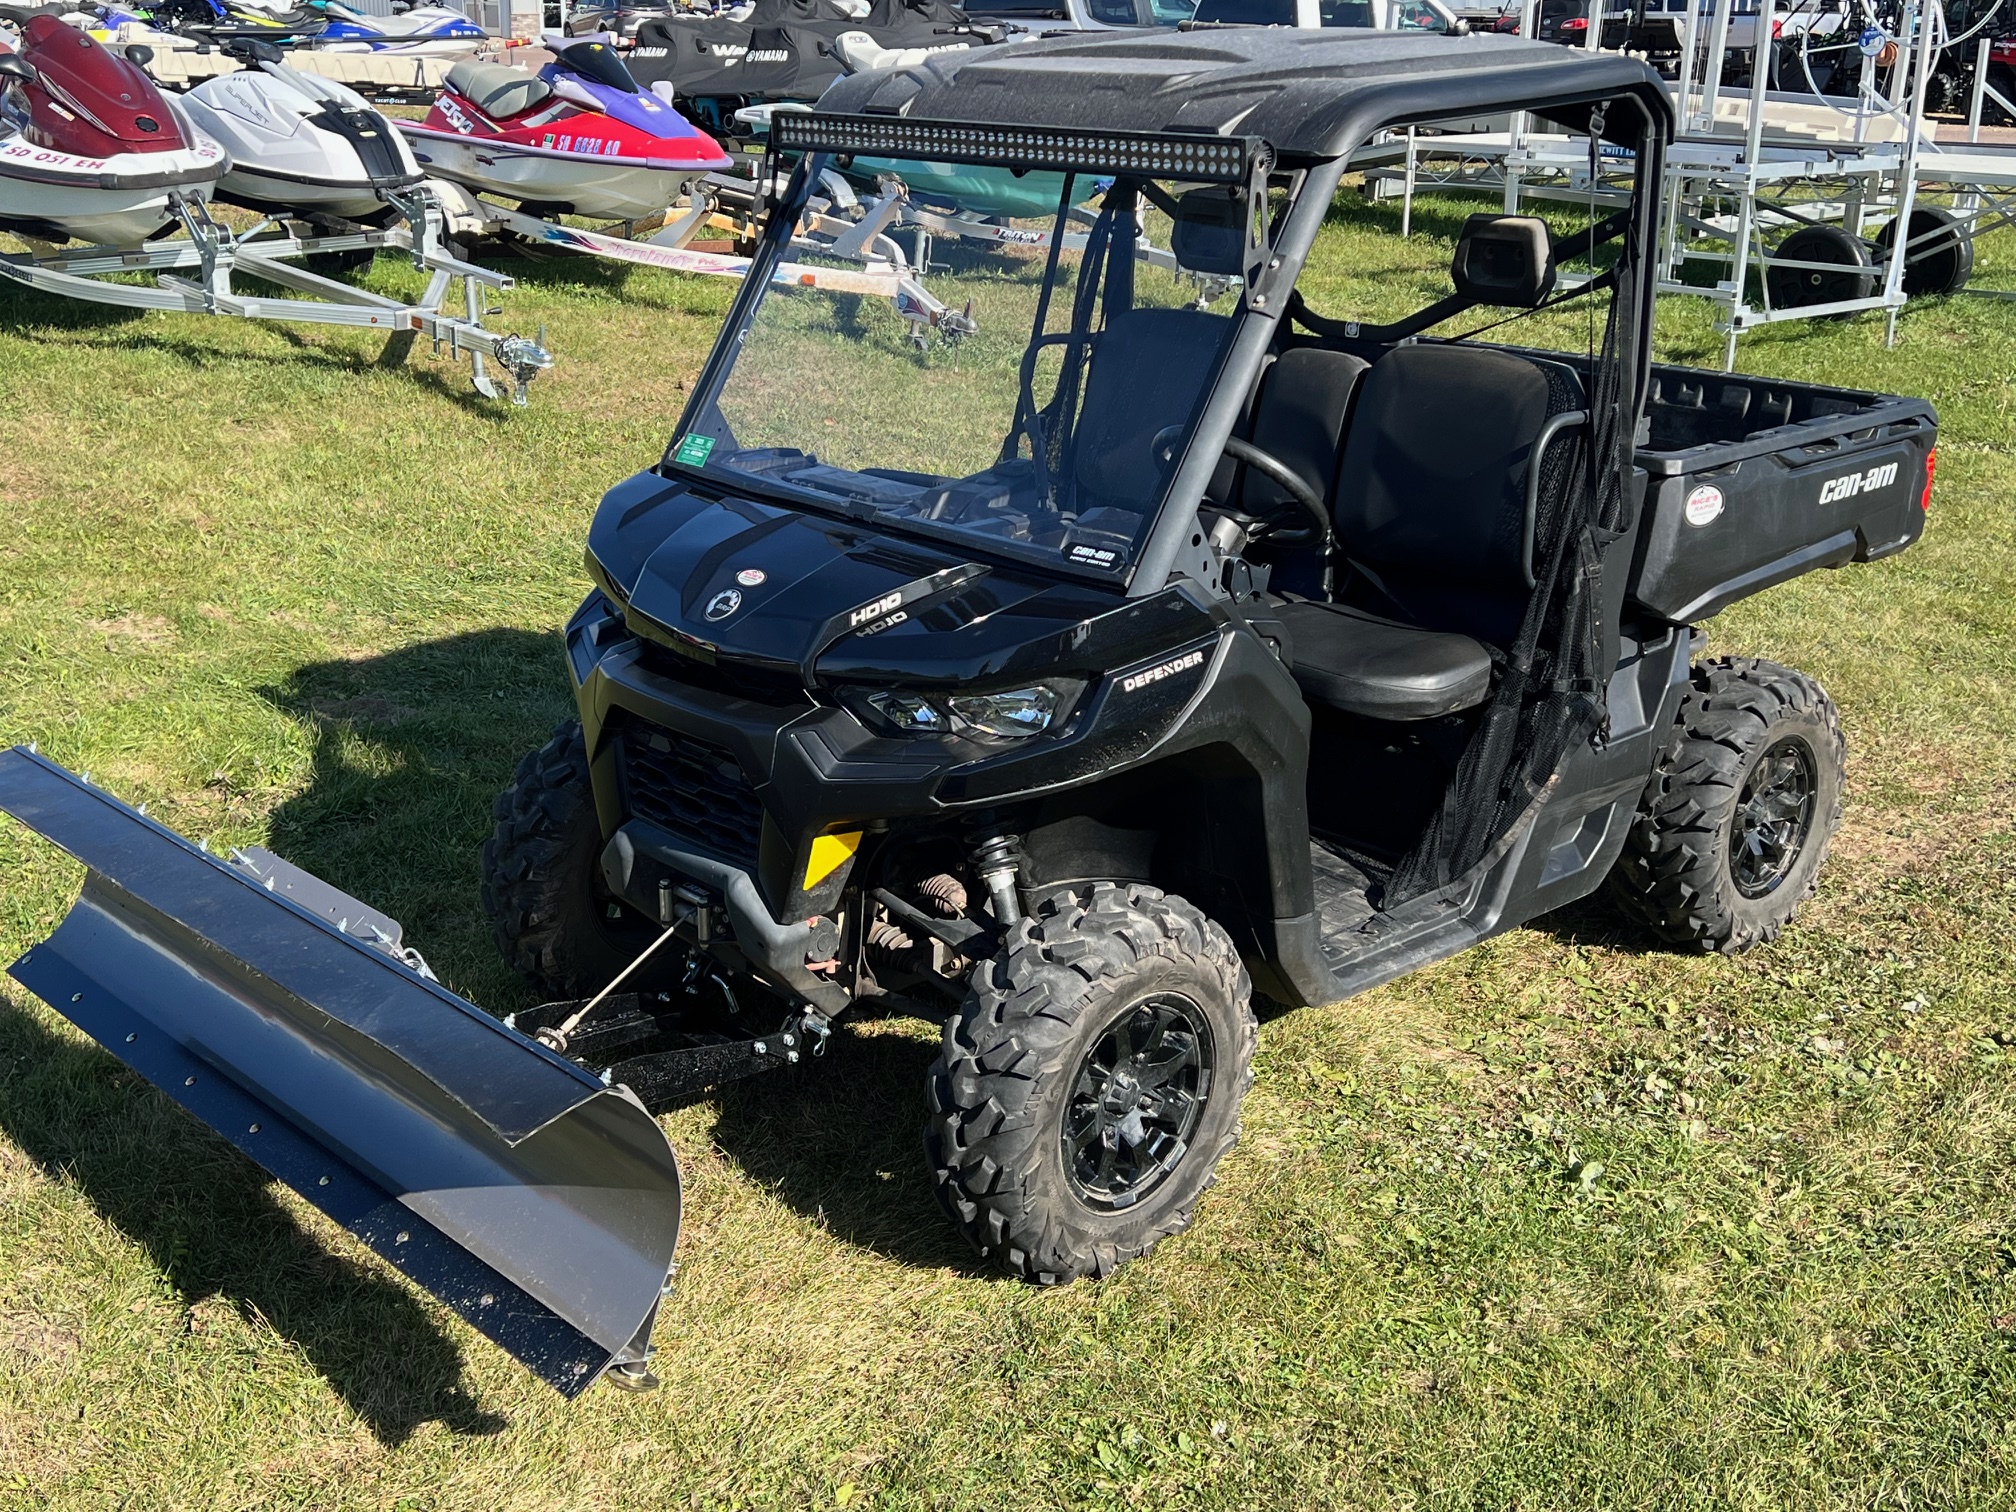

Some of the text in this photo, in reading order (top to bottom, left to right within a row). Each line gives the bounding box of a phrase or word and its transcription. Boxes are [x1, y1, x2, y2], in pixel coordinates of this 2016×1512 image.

[636, 47, 668, 57] YAMAHA
[755, 50, 788, 62] YAMAHA
[4, 146, 32, 157] SD
[73, 159, 106, 169] EH
[998, 228, 1041, 241] TRITON
[850, 592, 902, 627] HD10
[1123, 650, 1204, 692] DEFENDER
